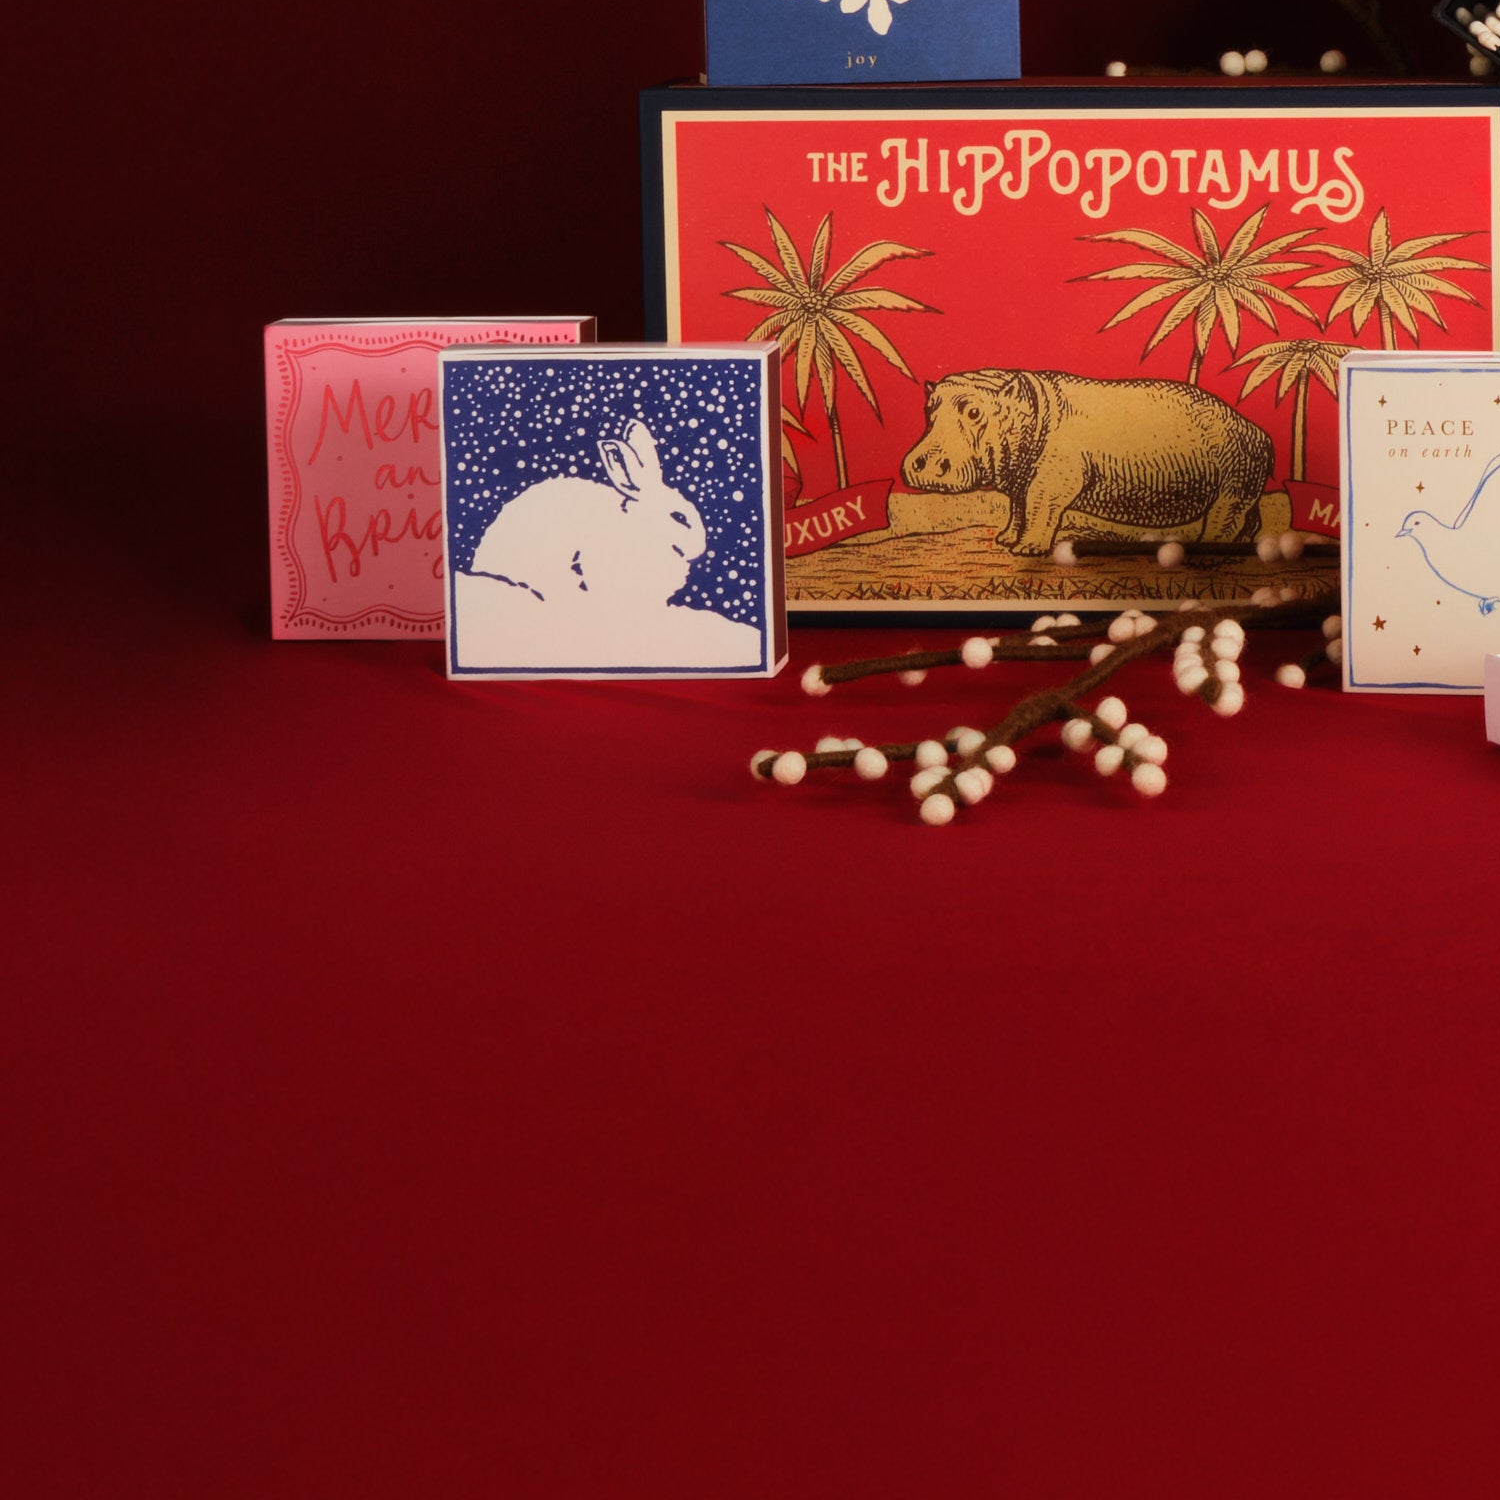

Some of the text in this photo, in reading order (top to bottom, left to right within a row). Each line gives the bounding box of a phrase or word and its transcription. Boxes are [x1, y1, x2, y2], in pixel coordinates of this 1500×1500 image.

[844, 50, 877, 69] joy
[807, 129, 1365, 222] THE HIPPOPOTAMUS
[1386, 419, 1474, 436] PEACE
[1388, 444, 1472, 458] on earth
[374, 463, 442, 490] an
[784, 495, 867, 549] UXURY
